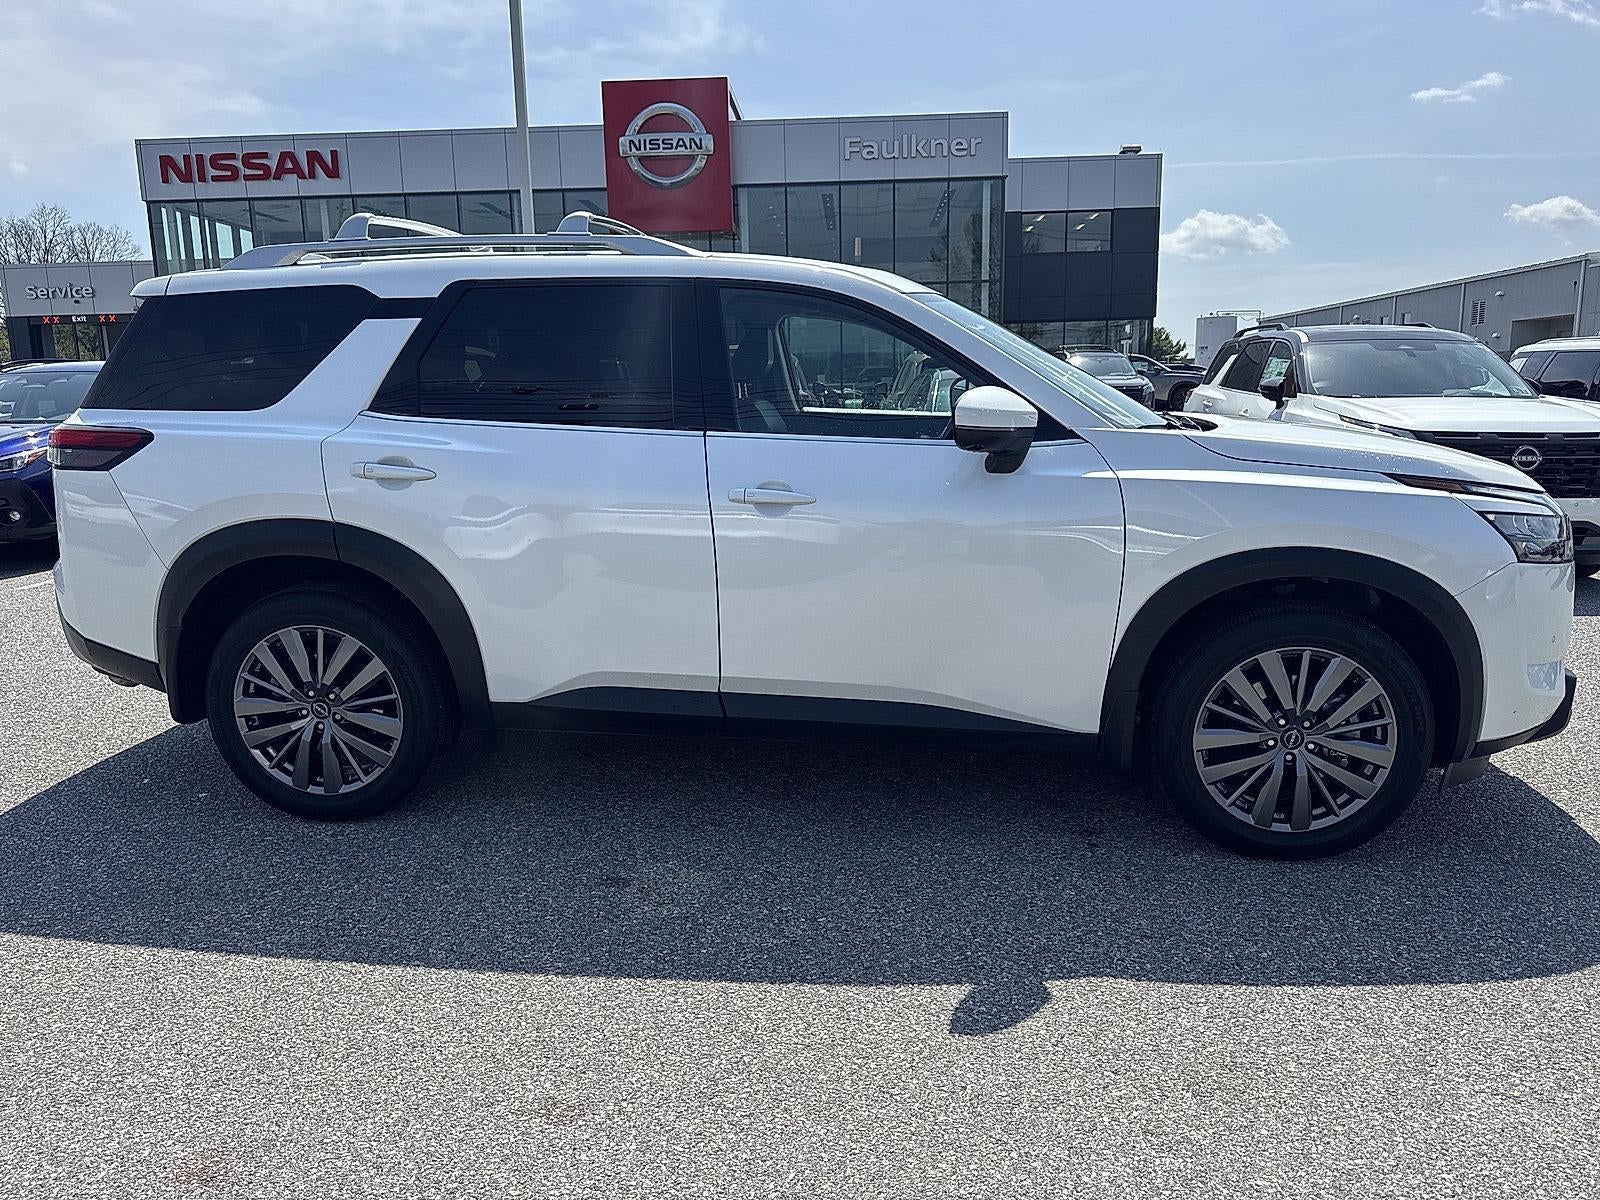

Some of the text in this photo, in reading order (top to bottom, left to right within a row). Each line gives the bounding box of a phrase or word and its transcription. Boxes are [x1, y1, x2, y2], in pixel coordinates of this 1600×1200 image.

[628, 138, 703, 152] NISSAN
[843, 133, 983, 161] Faulkner
[158, 149, 341, 184] NISSAN
[24, 283, 95, 300] Service
[71, 315, 87, 323] Exit
